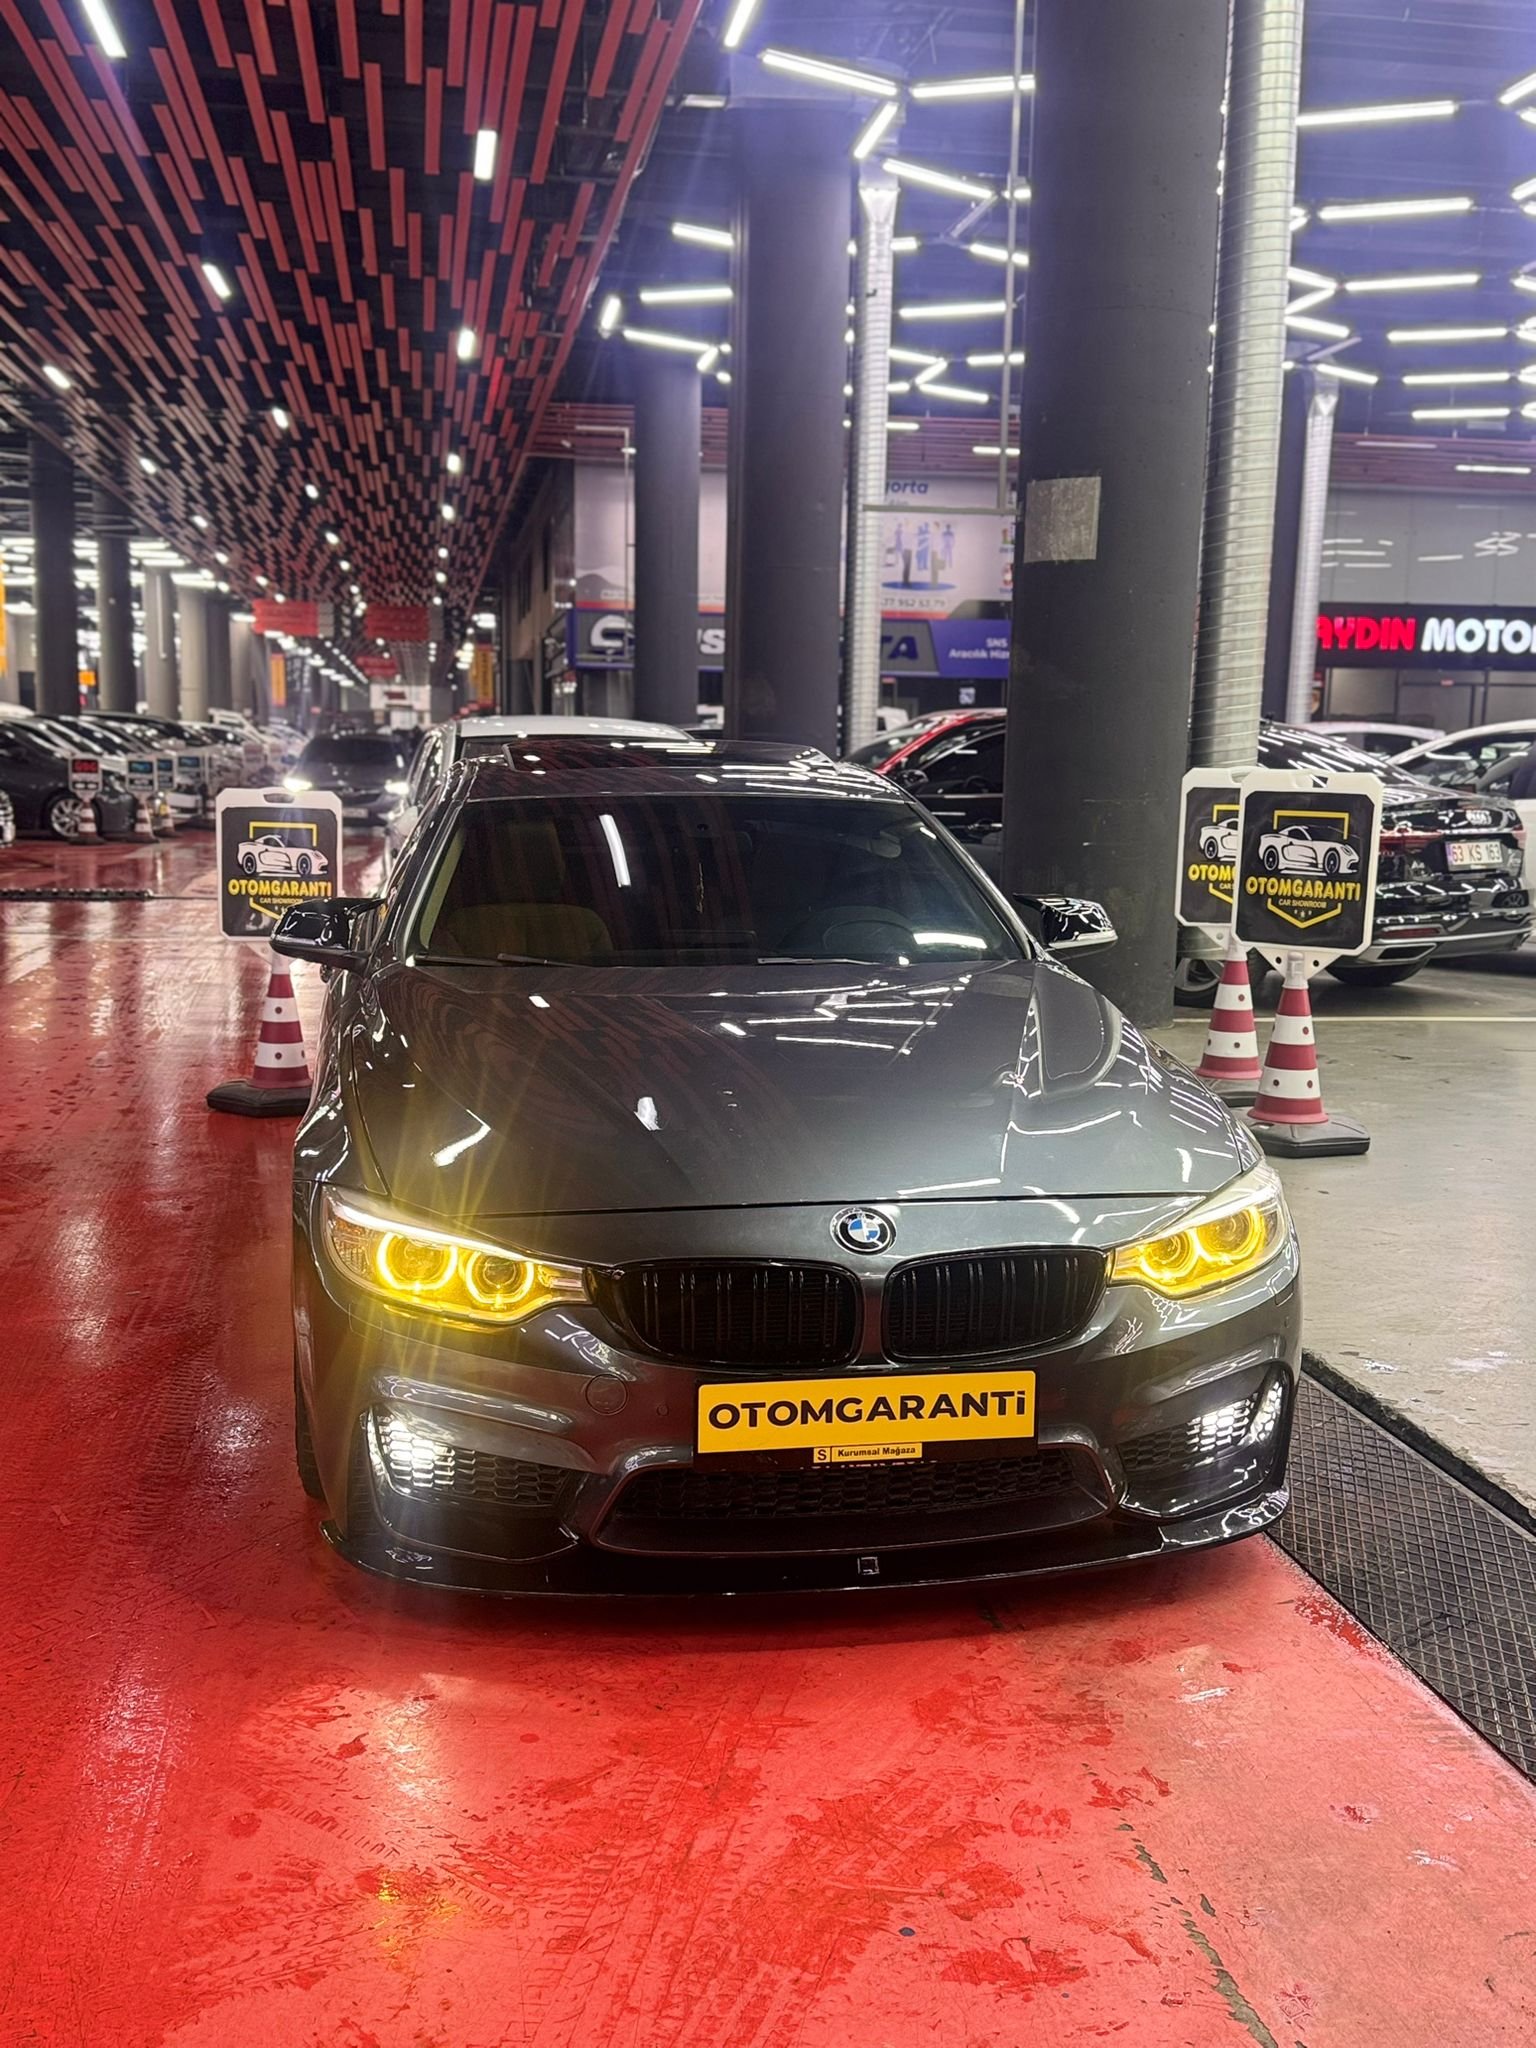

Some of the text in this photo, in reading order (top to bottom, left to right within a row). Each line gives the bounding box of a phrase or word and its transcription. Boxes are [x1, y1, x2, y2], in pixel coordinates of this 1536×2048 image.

[1316, 616, 1536, 653] AYDIN MOTO
[1452, 845, 1464, 862] 63
[1468, 844, 1482, 861] KS
[1188, 864, 1236, 881] OTOM
[227, 879, 332, 897] OTOMGARANTI
[1245, 876, 1361, 902] OTOMGARANTI
[1278, 898, 1291, 907] CAR
[837, 1448, 880, 1457] Kurumsal
